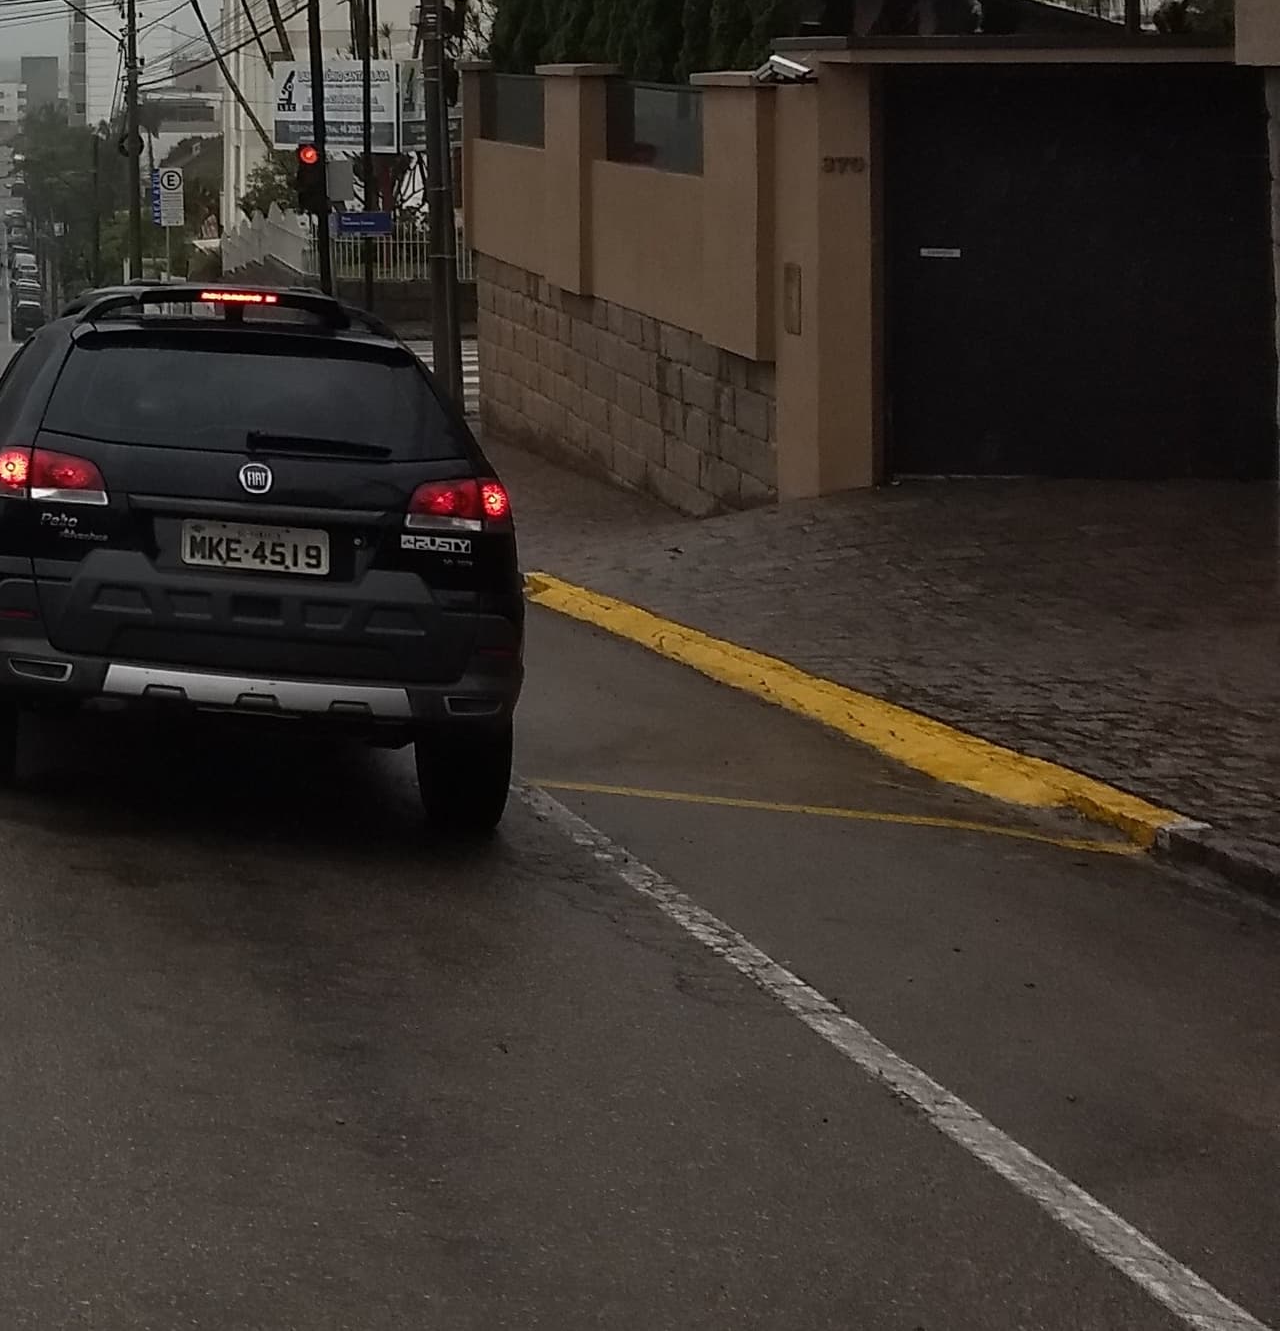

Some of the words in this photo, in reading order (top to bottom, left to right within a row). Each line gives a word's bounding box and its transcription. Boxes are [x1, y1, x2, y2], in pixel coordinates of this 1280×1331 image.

[167, 174, 175, 186] E
[247, 471, 266, 486] FIAT
[415, 536, 471, 553] RUSTY
